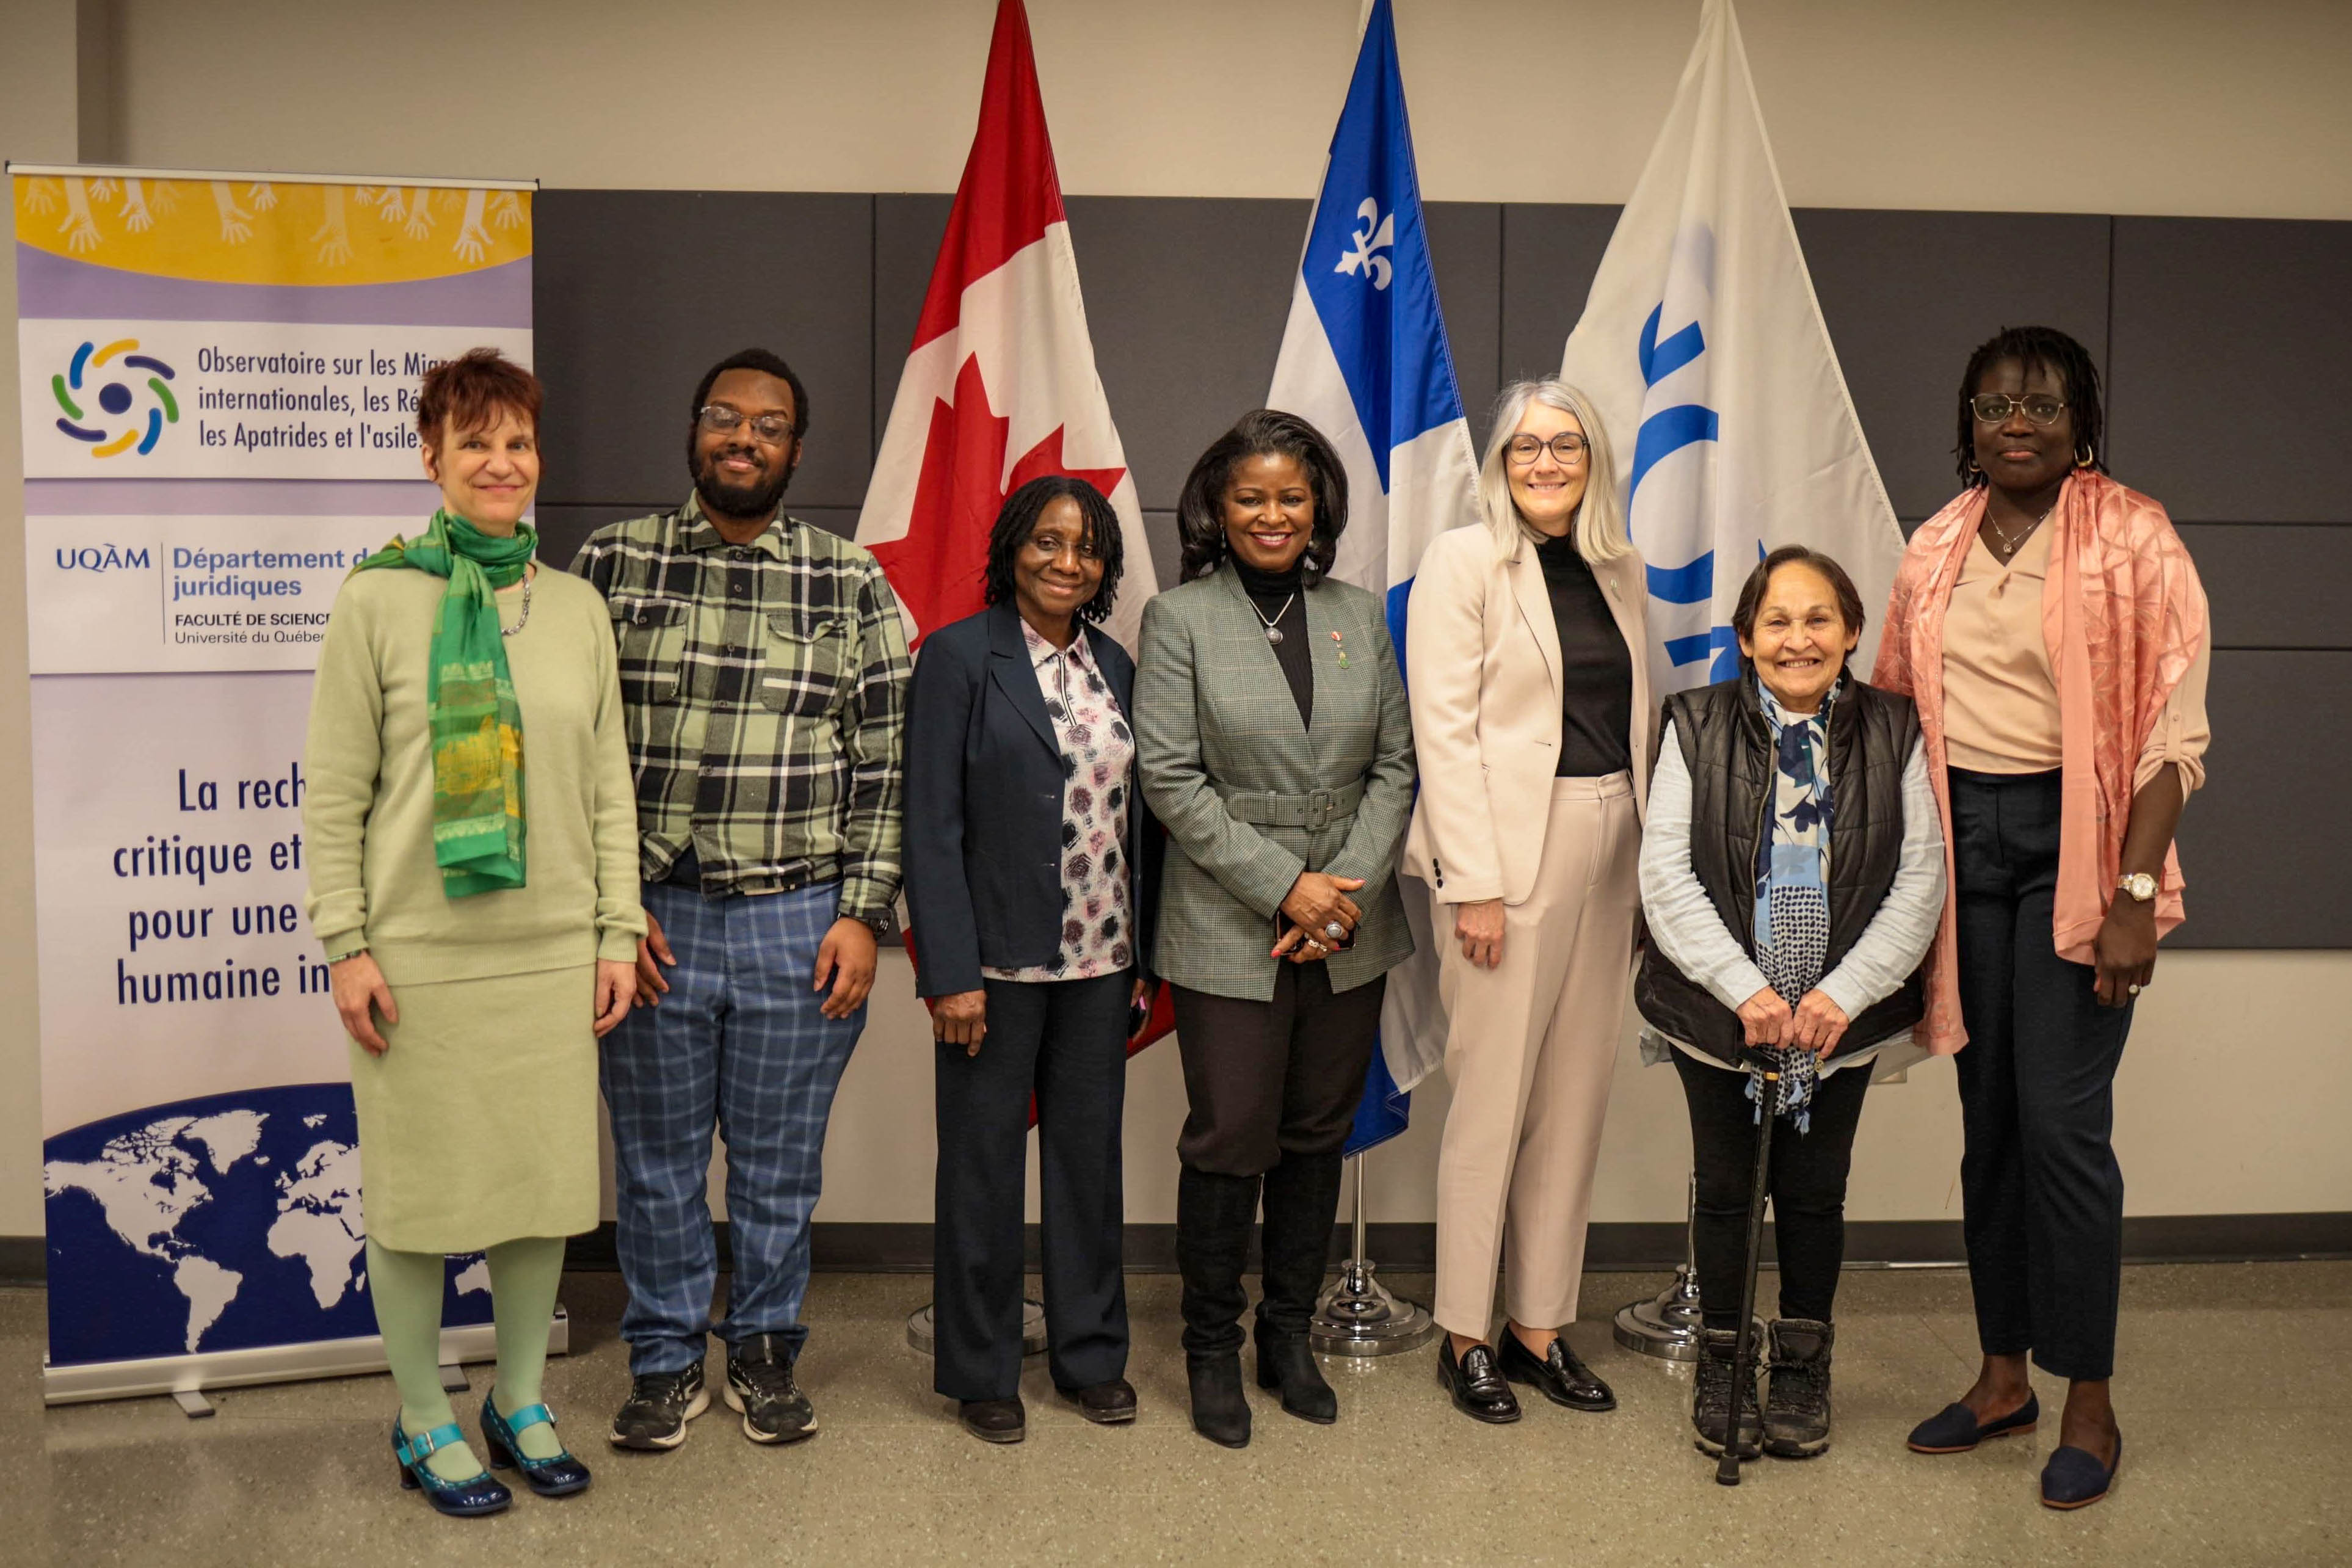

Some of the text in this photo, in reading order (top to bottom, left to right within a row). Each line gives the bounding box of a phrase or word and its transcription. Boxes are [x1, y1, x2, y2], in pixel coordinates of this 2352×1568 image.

[198, 346, 325, 375] Observatoire
[333, 358, 363, 375] sur
[371, 349, 396, 376] les
[199, 385, 355, 416] internationales,
[364, 385, 390, 412] les
[200, 419, 227, 446] les
[234, 421, 328, 452] Apatrides
[335, 427, 353, 448] et
[56, 543, 150, 573] UQÀM
[173, 548, 346, 573] Département
[173, 575, 302, 601] juridiques
[175, 614, 242, 626] FACULTÉ
[246, 614, 266, 626] DE
[175, 632, 247, 644] Université
[252, 631, 269, 643] du
[179, 769, 217, 811] La
[114, 834, 302, 886] critique et
[129, 904, 297, 952] pour une
[117, 959, 280, 1004] humaine
